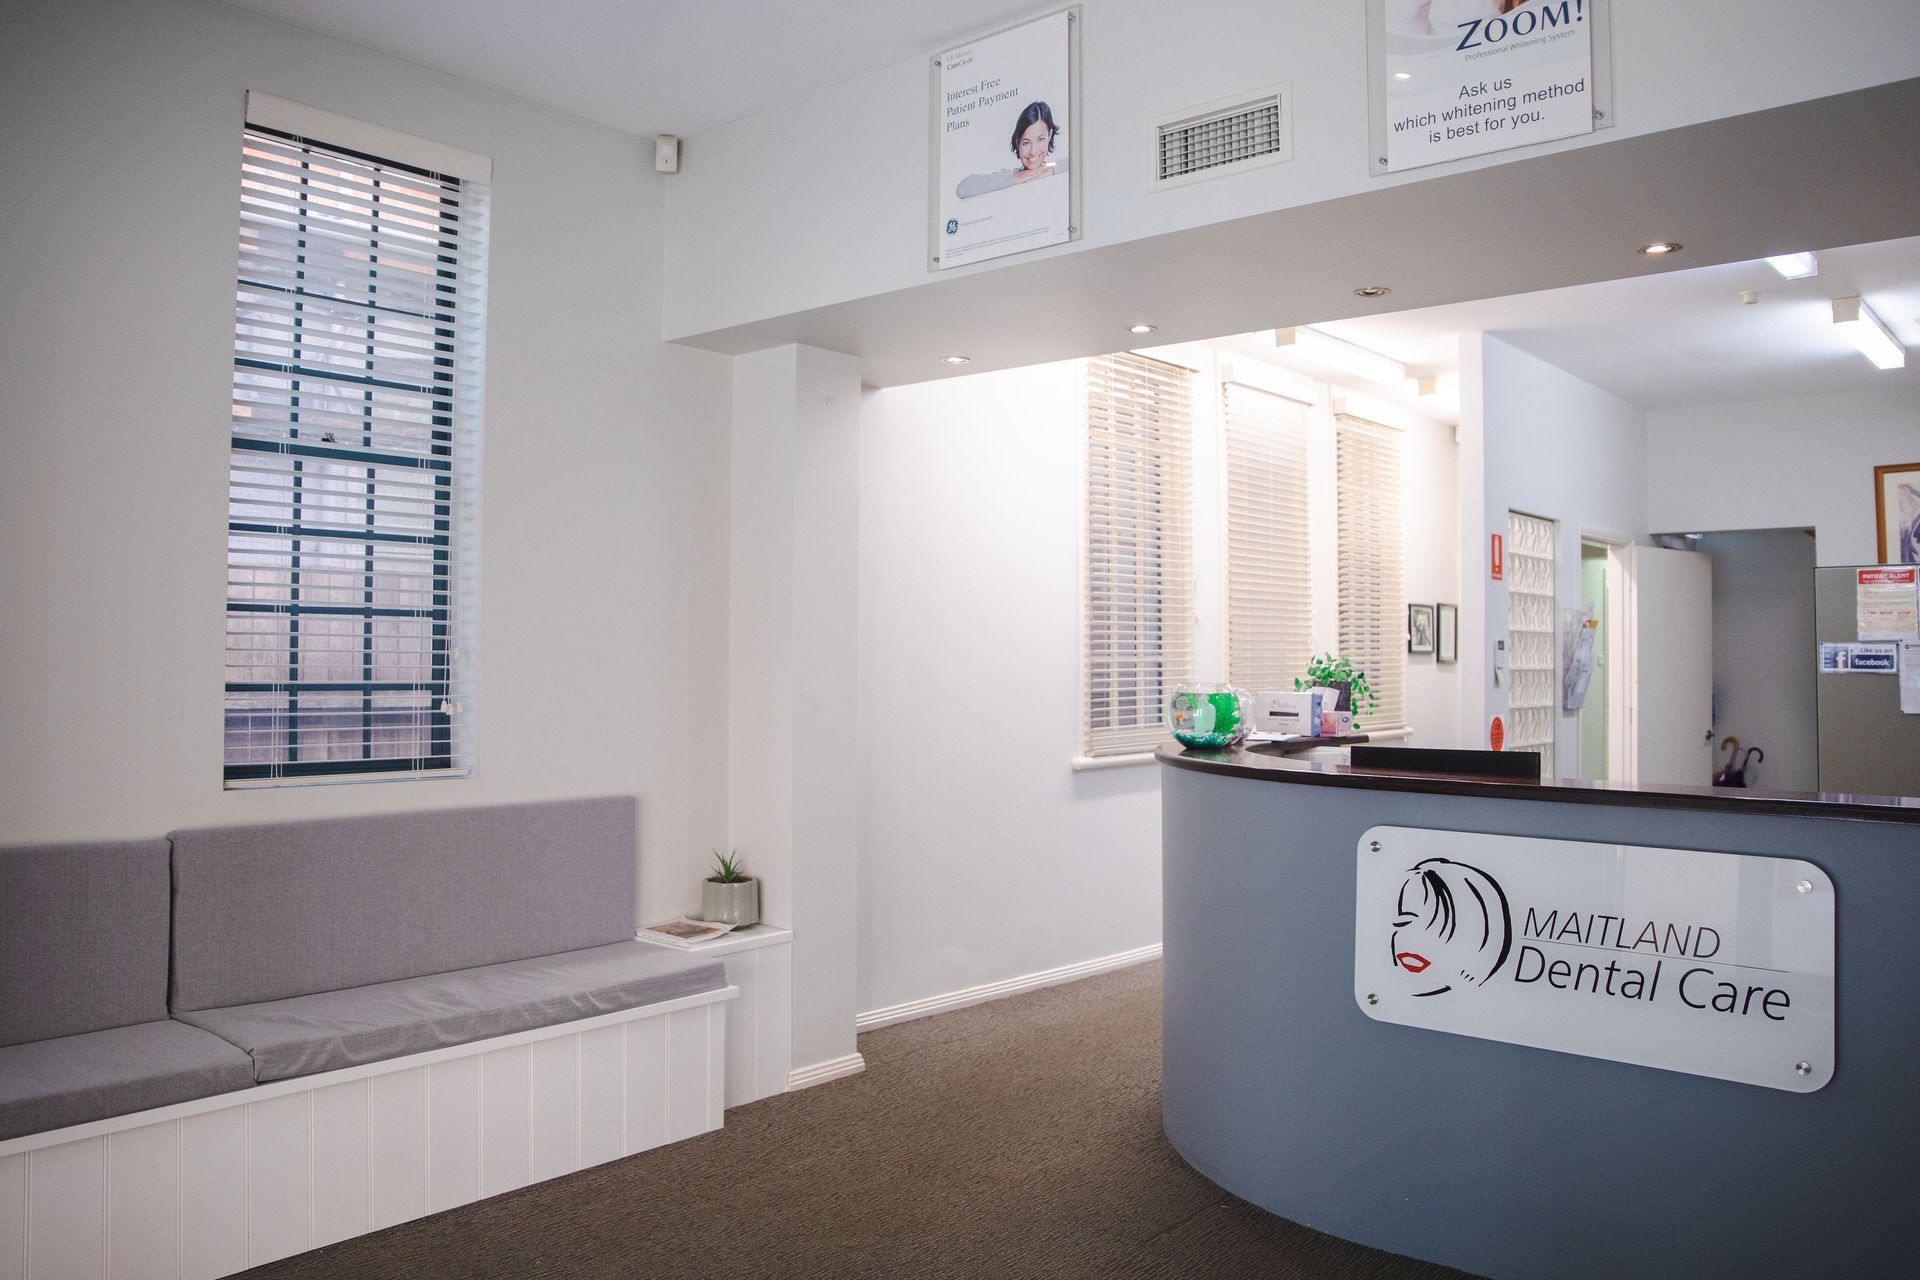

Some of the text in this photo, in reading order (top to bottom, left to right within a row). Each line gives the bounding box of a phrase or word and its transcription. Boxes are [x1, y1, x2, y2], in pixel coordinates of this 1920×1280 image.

[1456, 0, 1583, 51] ZOOM!
[1464, 29, 1576, 61] Professional Whitening System
[947, 78, 1001, 102] Interest Free
[947, 88, 1019, 117] Patient Payment
[1458, 78, 1512, 99] Ask us
[1394, 78, 1585, 132] which whitening method
[947, 119, 970, 132] Plans
[1429, 110, 1545, 143] is best for you.
[1855, 658, 1890, 666] facebook
[1523, 907, 1721, 959] MAITLAND
[1514, 945, 1791, 1021] Dental Care
